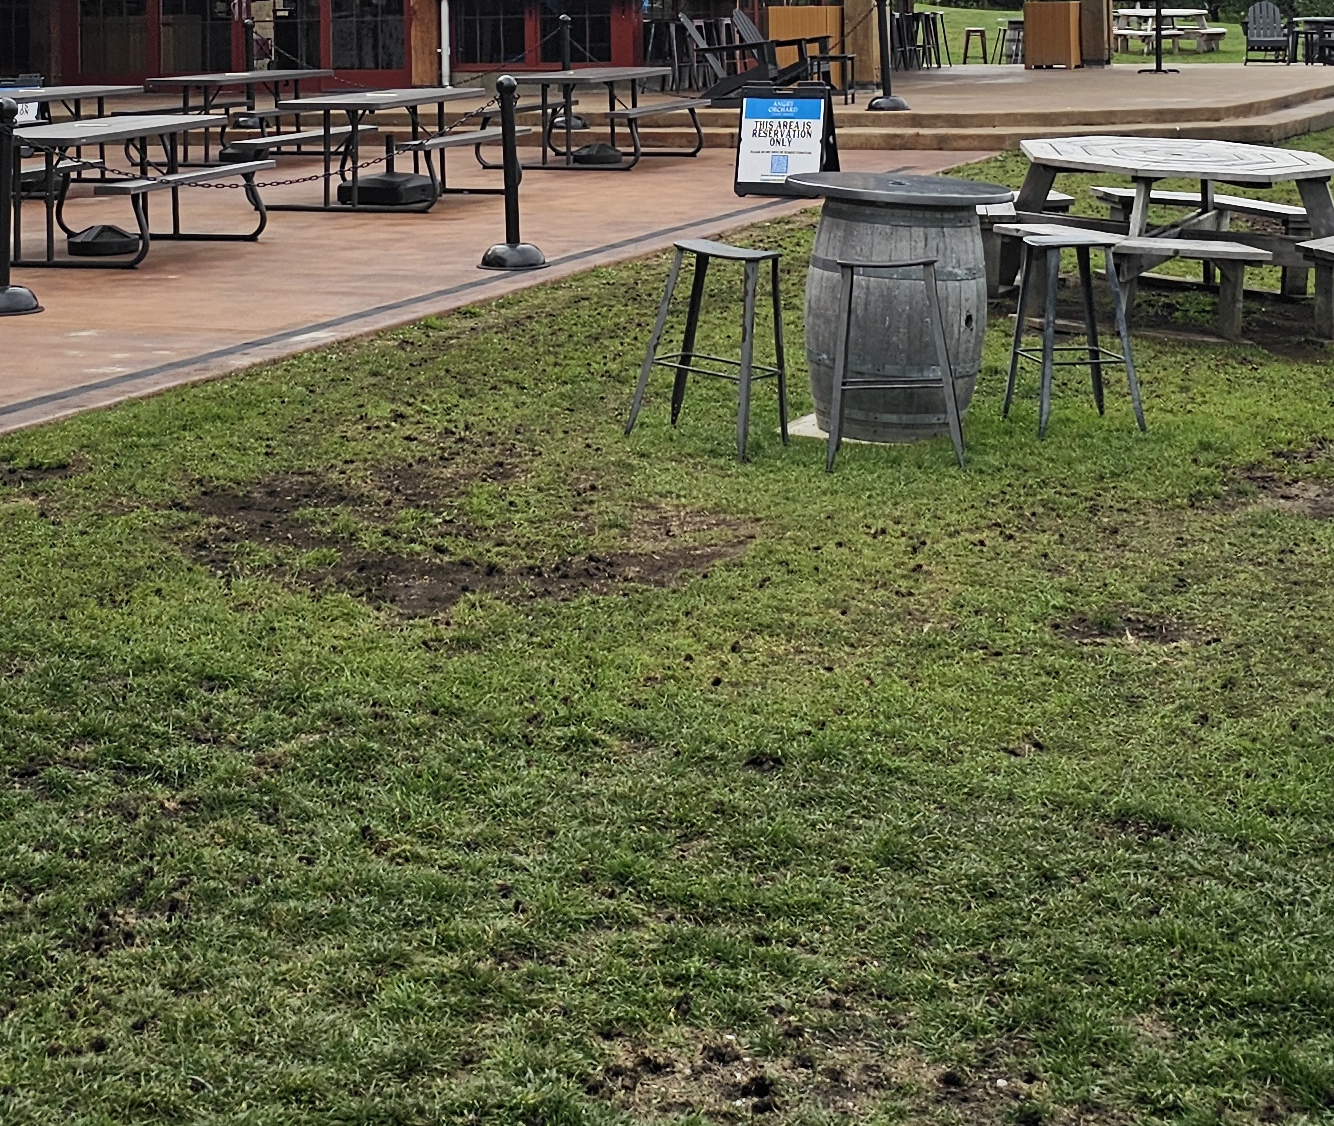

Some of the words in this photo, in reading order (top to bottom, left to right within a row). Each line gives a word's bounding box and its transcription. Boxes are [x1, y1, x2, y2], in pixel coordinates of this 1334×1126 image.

[754, 120, 774, 130] THIS
[777, 120, 799, 130] AREA
[802, 121, 812, 130] IS
[752, 129, 812, 138] RESERVATION
[769, 137, 792, 147] ONLY
